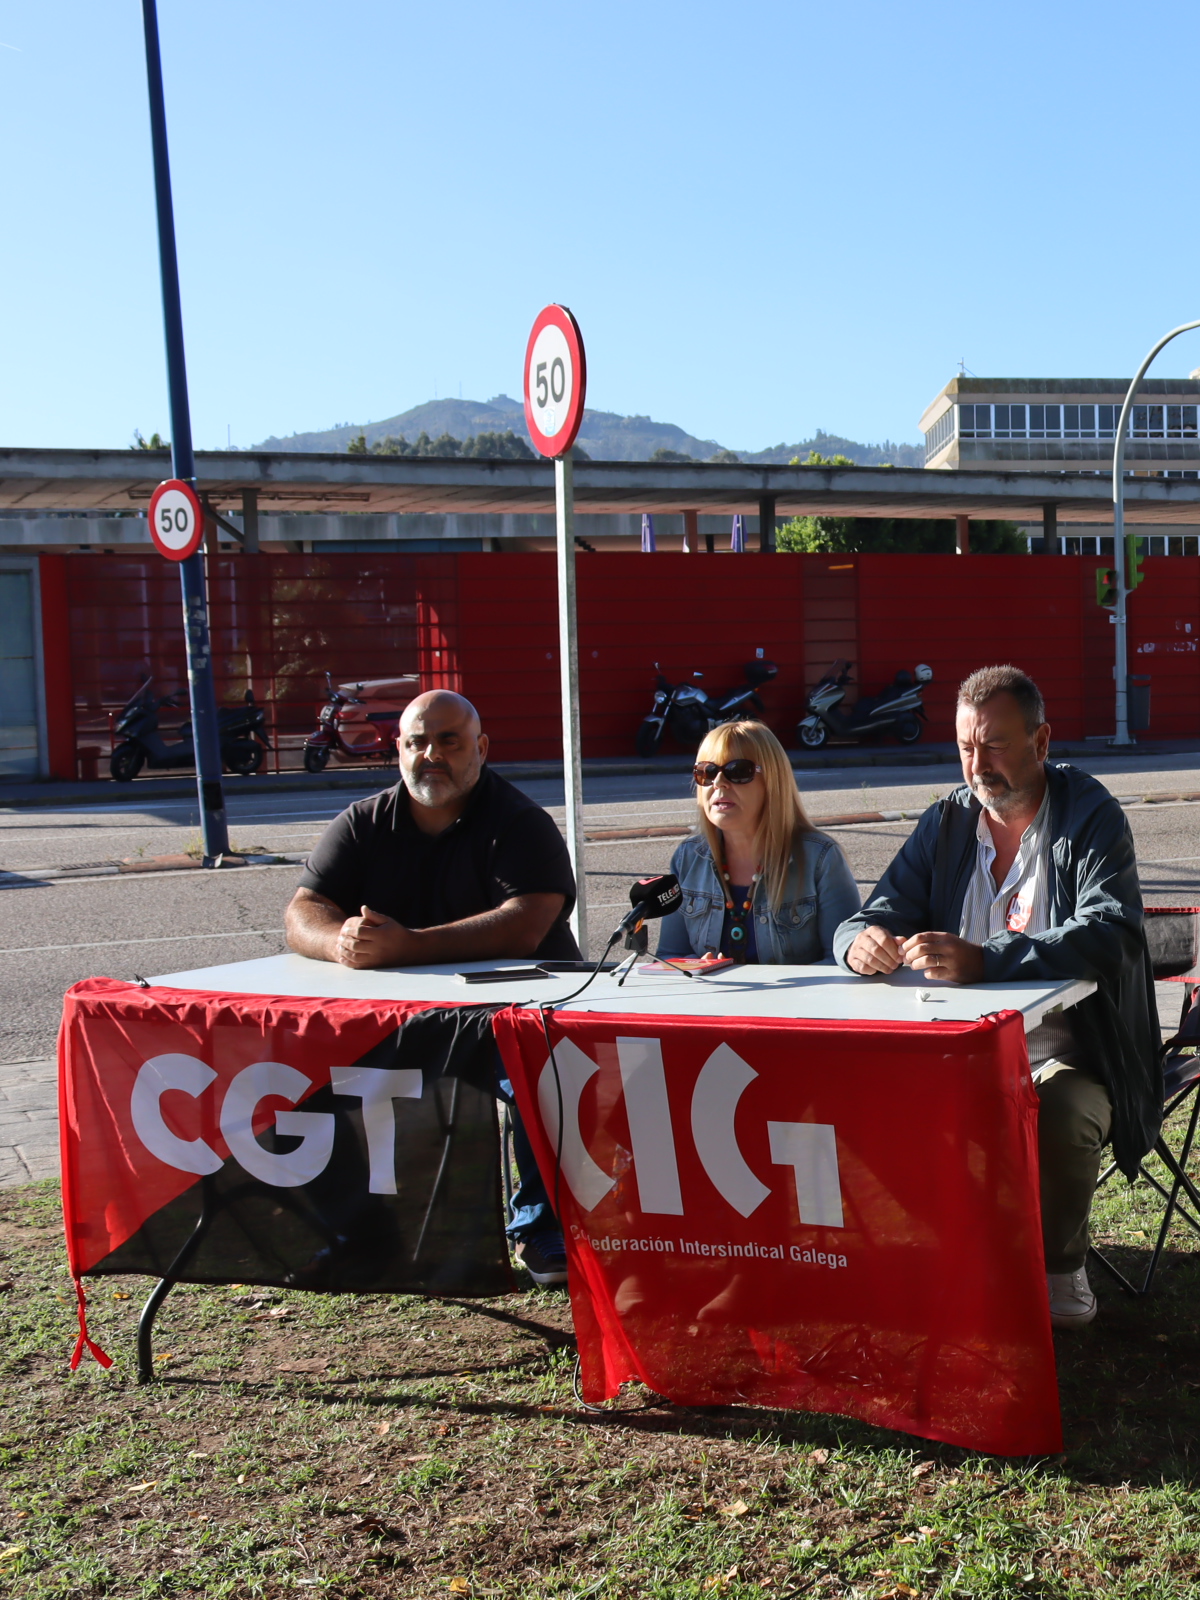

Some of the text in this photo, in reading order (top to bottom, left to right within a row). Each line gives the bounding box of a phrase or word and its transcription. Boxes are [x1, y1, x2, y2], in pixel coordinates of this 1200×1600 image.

[536, 357, 566, 408] 50
[161, 507, 188, 533] 50
[131, 1053, 423, 1195] CGT
[537, 1036, 844, 1228] CIG
[680, 1237, 784, 1260] Intersindical
[790, 1245, 848, 1270] Galega
